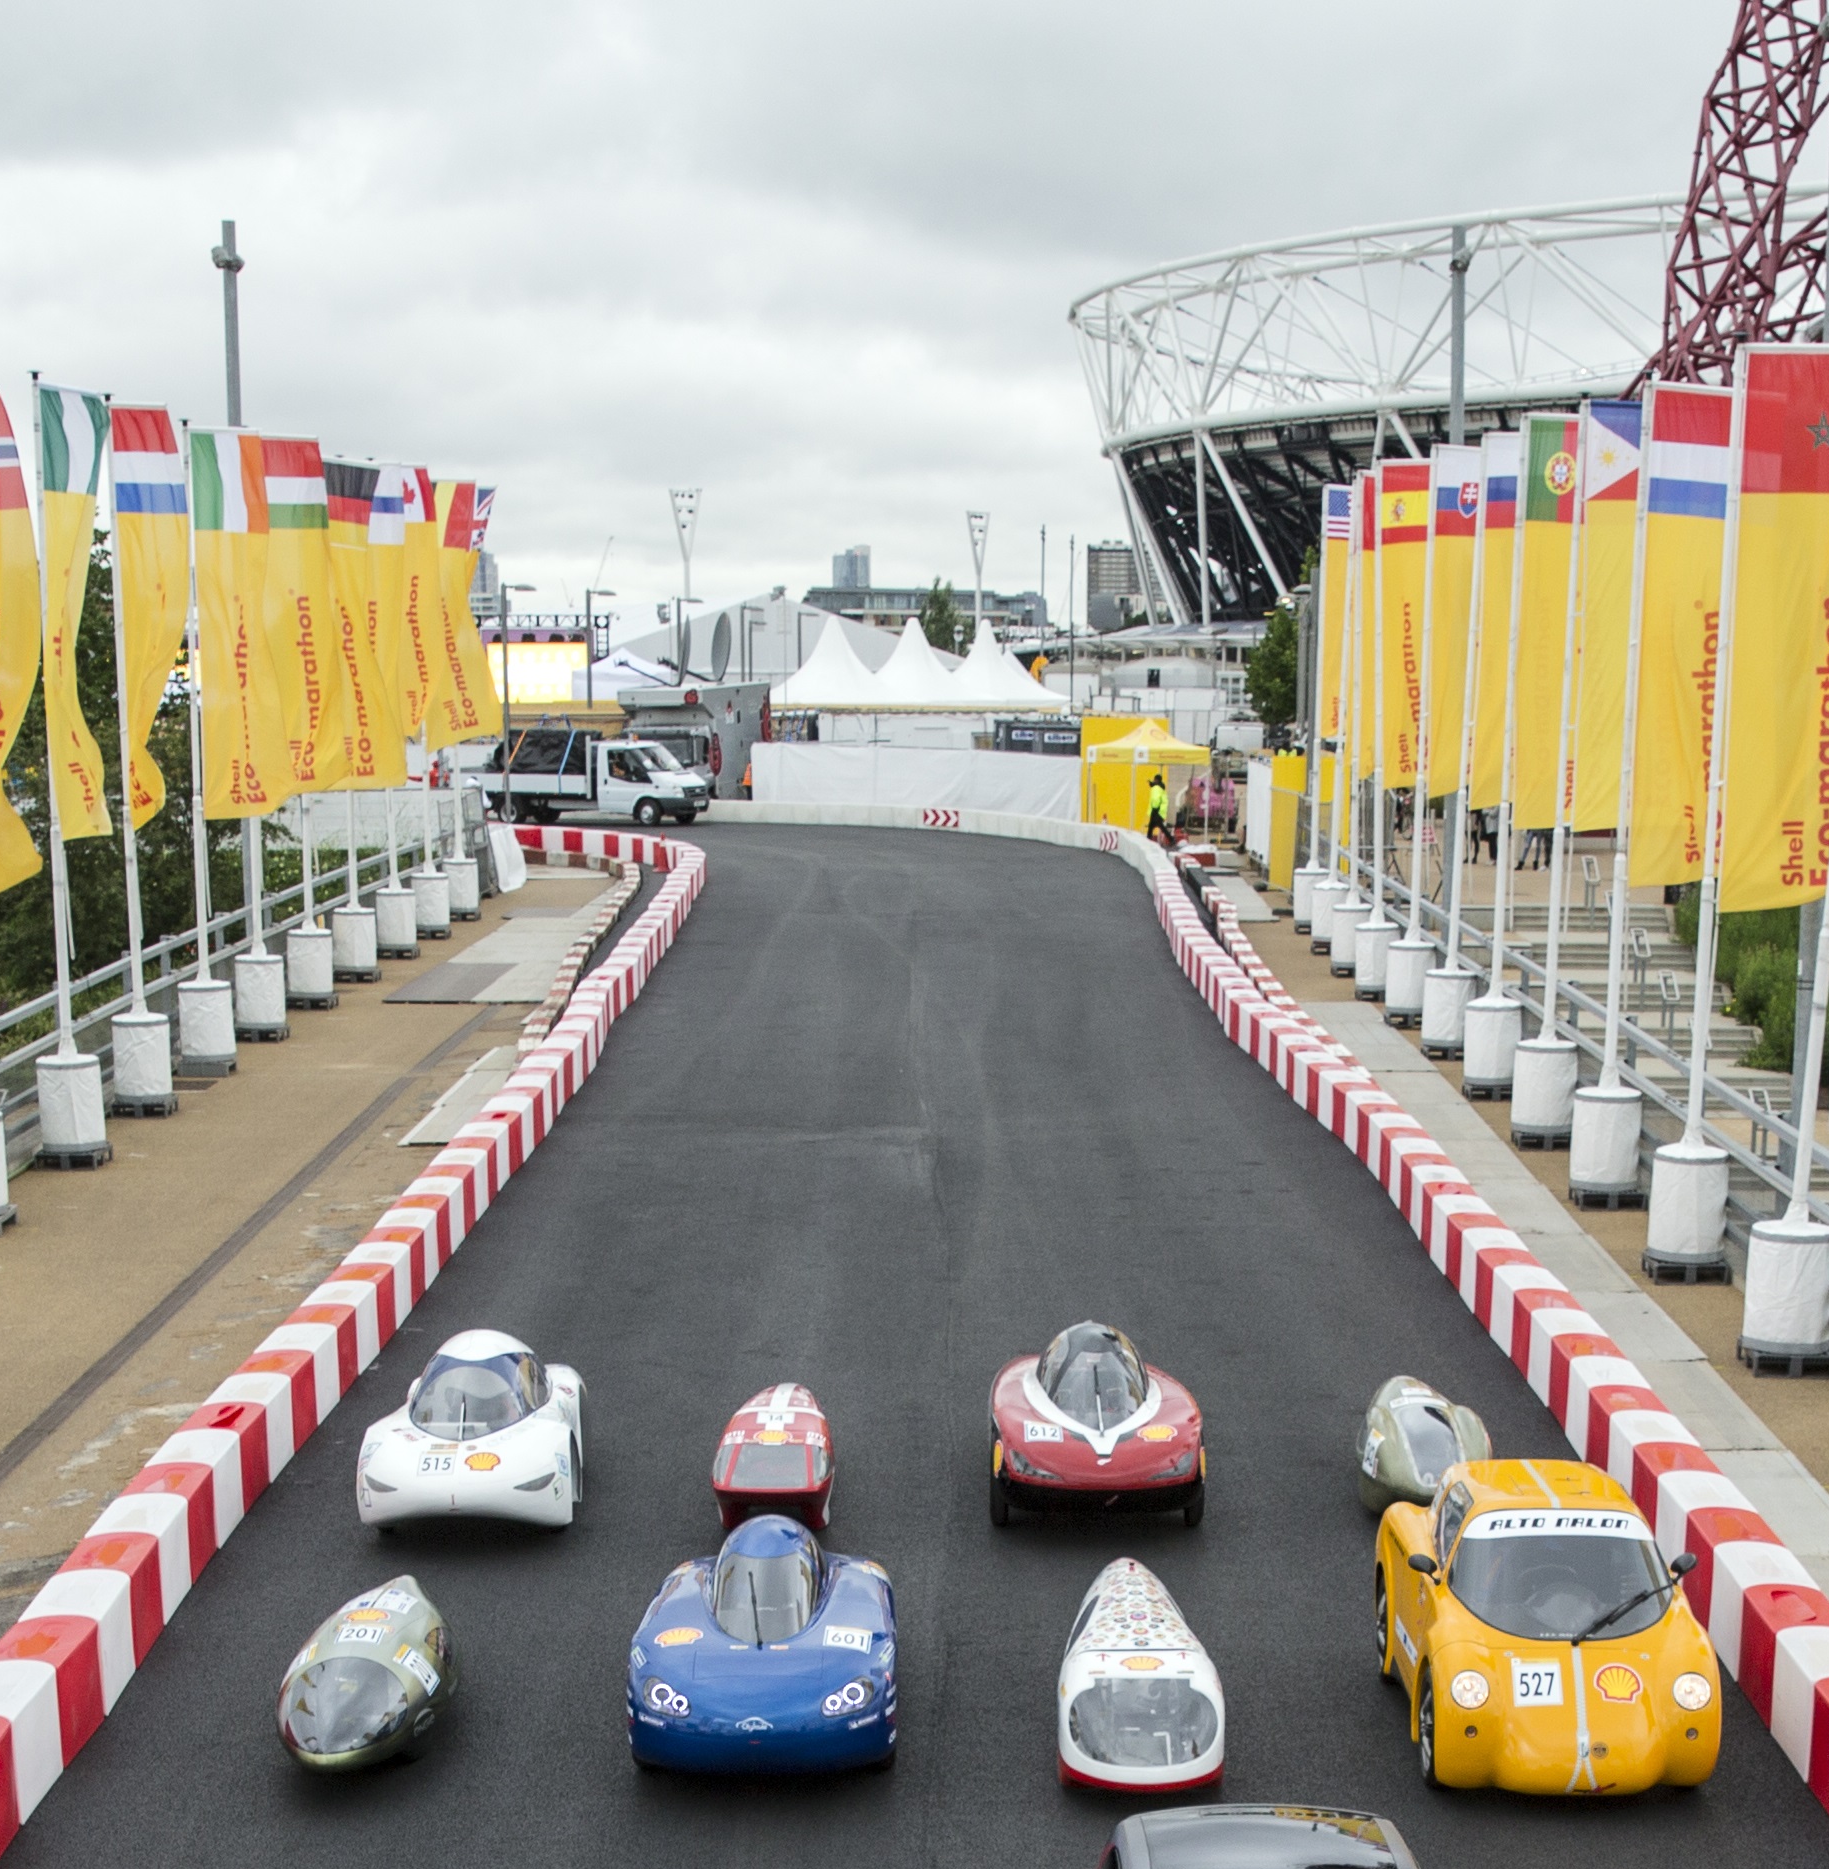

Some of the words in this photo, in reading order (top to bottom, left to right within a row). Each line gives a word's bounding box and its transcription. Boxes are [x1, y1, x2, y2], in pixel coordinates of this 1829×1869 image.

[296, 596, 321, 781] Eco-marathon
[443, 700, 461, 731] Shell
[1399, 733, 1411, 774] Shell
[230, 760, 246, 804] Shell
[1780, 821, 1804, 886] Shell
[1030, 1426, 1058, 1438] 612
[422, 1456, 451, 1471] 515
[1489, 1518, 1545, 1531] ALTO
[344, 1628, 378, 1640] 201
[832, 1633, 865, 1647] 601
[1519, 1673, 1554, 1696] 527
